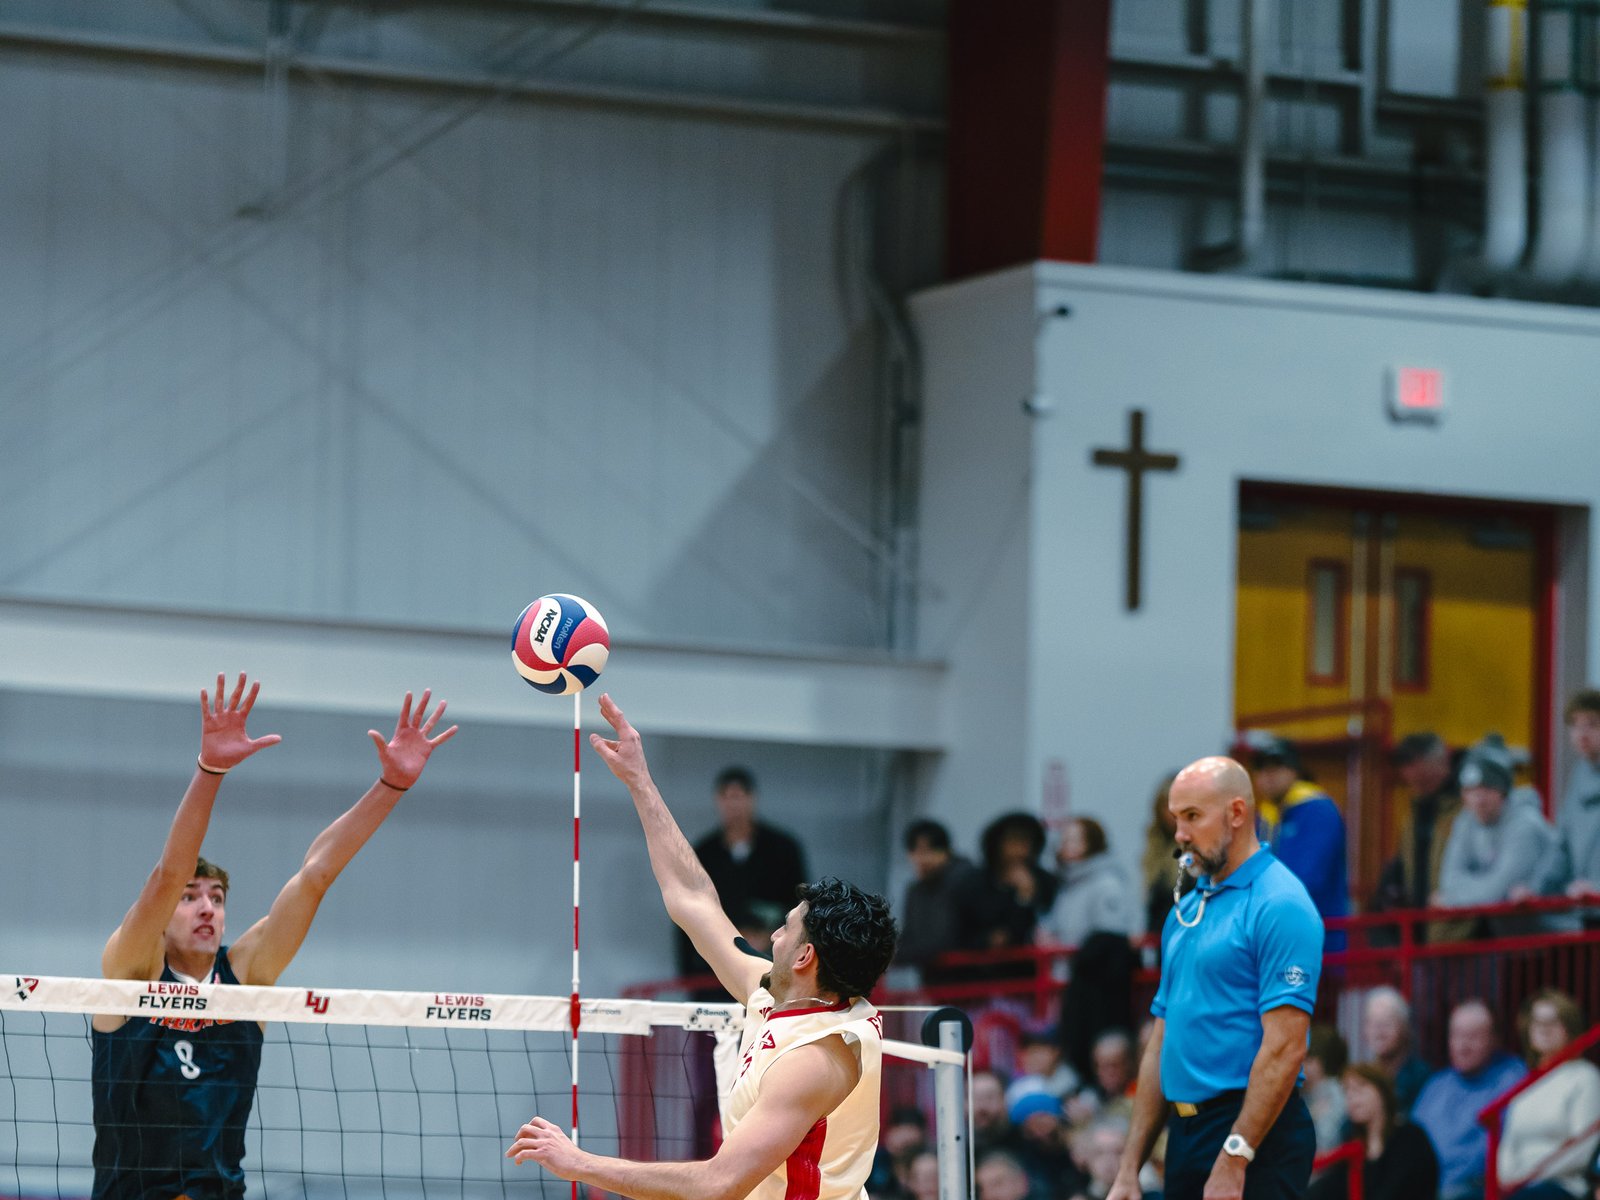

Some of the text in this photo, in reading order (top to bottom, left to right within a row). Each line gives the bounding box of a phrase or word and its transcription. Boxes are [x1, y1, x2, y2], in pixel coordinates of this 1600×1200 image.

[534, 608, 558, 644] NCAA
[554, 617, 574, 650] molten
[147, 982, 199, 996] LEWIS
[138, 995, 208, 1011] FLYERS
[434, 994, 485, 1007] LEWIS
[426, 1006, 492, 1021] FLYERS
[174, 1040, 201, 1080] 8
